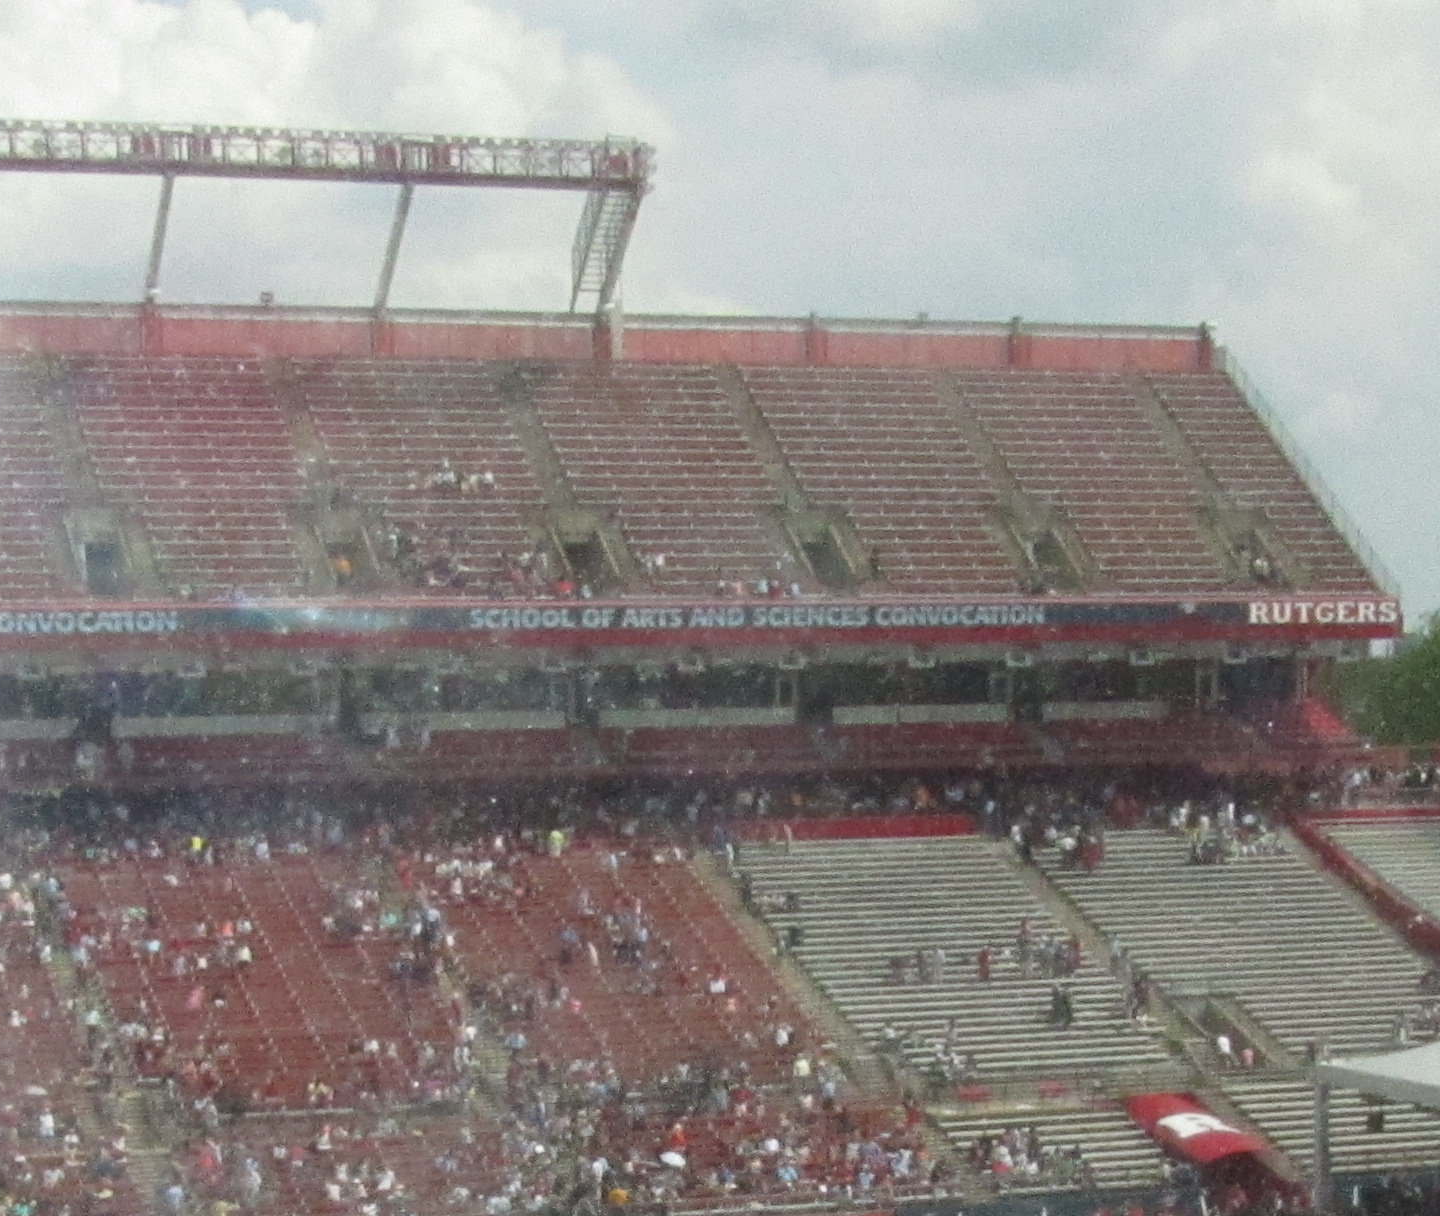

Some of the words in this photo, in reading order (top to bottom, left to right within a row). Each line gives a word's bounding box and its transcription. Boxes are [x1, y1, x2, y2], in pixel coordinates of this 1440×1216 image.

[469, 607, 577, 630] SCHOOL
[581, 607, 615, 629] OF
[621, 606, 684, 629] ARTS
[688, 606, 746, 628] AND
[751, 605, 870, 628] SCIENCES
[875, 604, 1045, 627] CONVOCATION
[1248, 600, 1398, 625] RUTGERS
